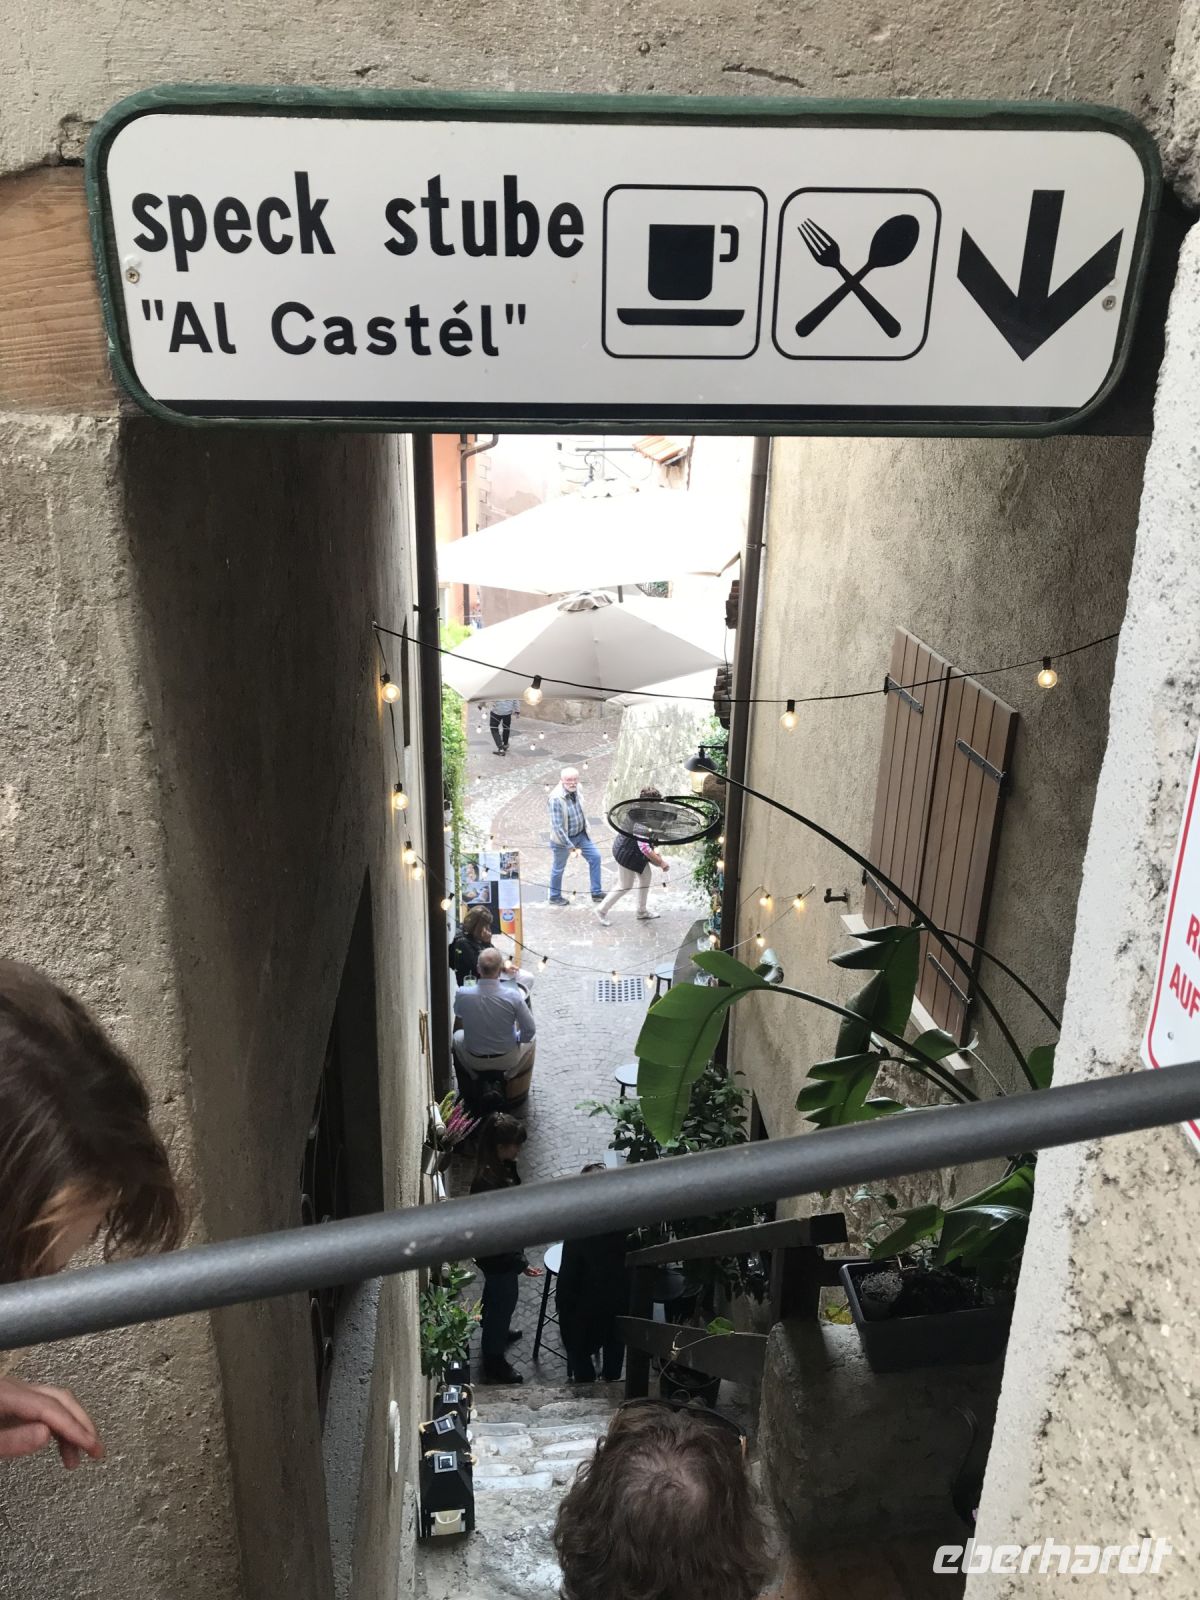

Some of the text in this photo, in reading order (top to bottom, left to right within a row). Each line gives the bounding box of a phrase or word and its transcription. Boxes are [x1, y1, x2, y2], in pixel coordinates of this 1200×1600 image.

[132, 171, 585, 272] speck stube
[141, 299, 527, 357] "Al Castél"
